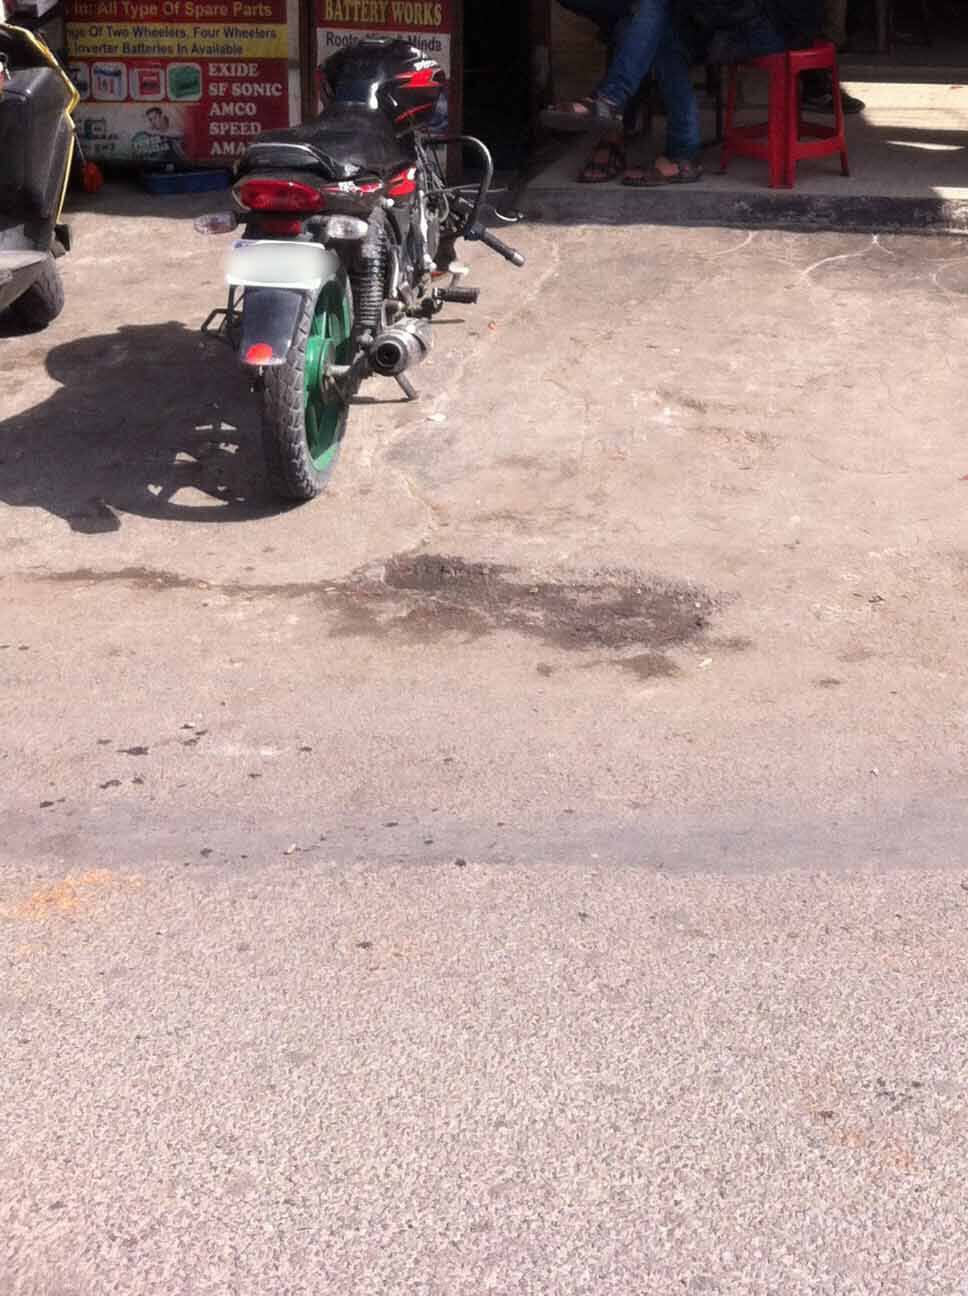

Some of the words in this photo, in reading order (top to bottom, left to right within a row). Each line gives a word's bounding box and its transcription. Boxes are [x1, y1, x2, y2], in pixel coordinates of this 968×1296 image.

[122, 1, 158, 20] Type
[163, 1, 181, 16] Of
[185, 1, 228, 20] Spare
[233, 2, 273, 17] Parts
[392, 1, 443, 26] WORKS
[106, 25, 129, 39] Two
[193, 27, 220, 39] Four
[223, 26, 277, 40] Wheelers
[122, 43, 174, 55] Batteries
[177, 44, 189, 55] In
[191, 43, 243, 56] Available
[208, 63, 259, 77] EXIDE
[208, 82, 228, 97] SF
[232, 82, 283, 96] SONIC
[209, 103, 257, 117] AMCO
[208, 122, 261, 136] SPEED
[209, 142, 247, 156] AMA
